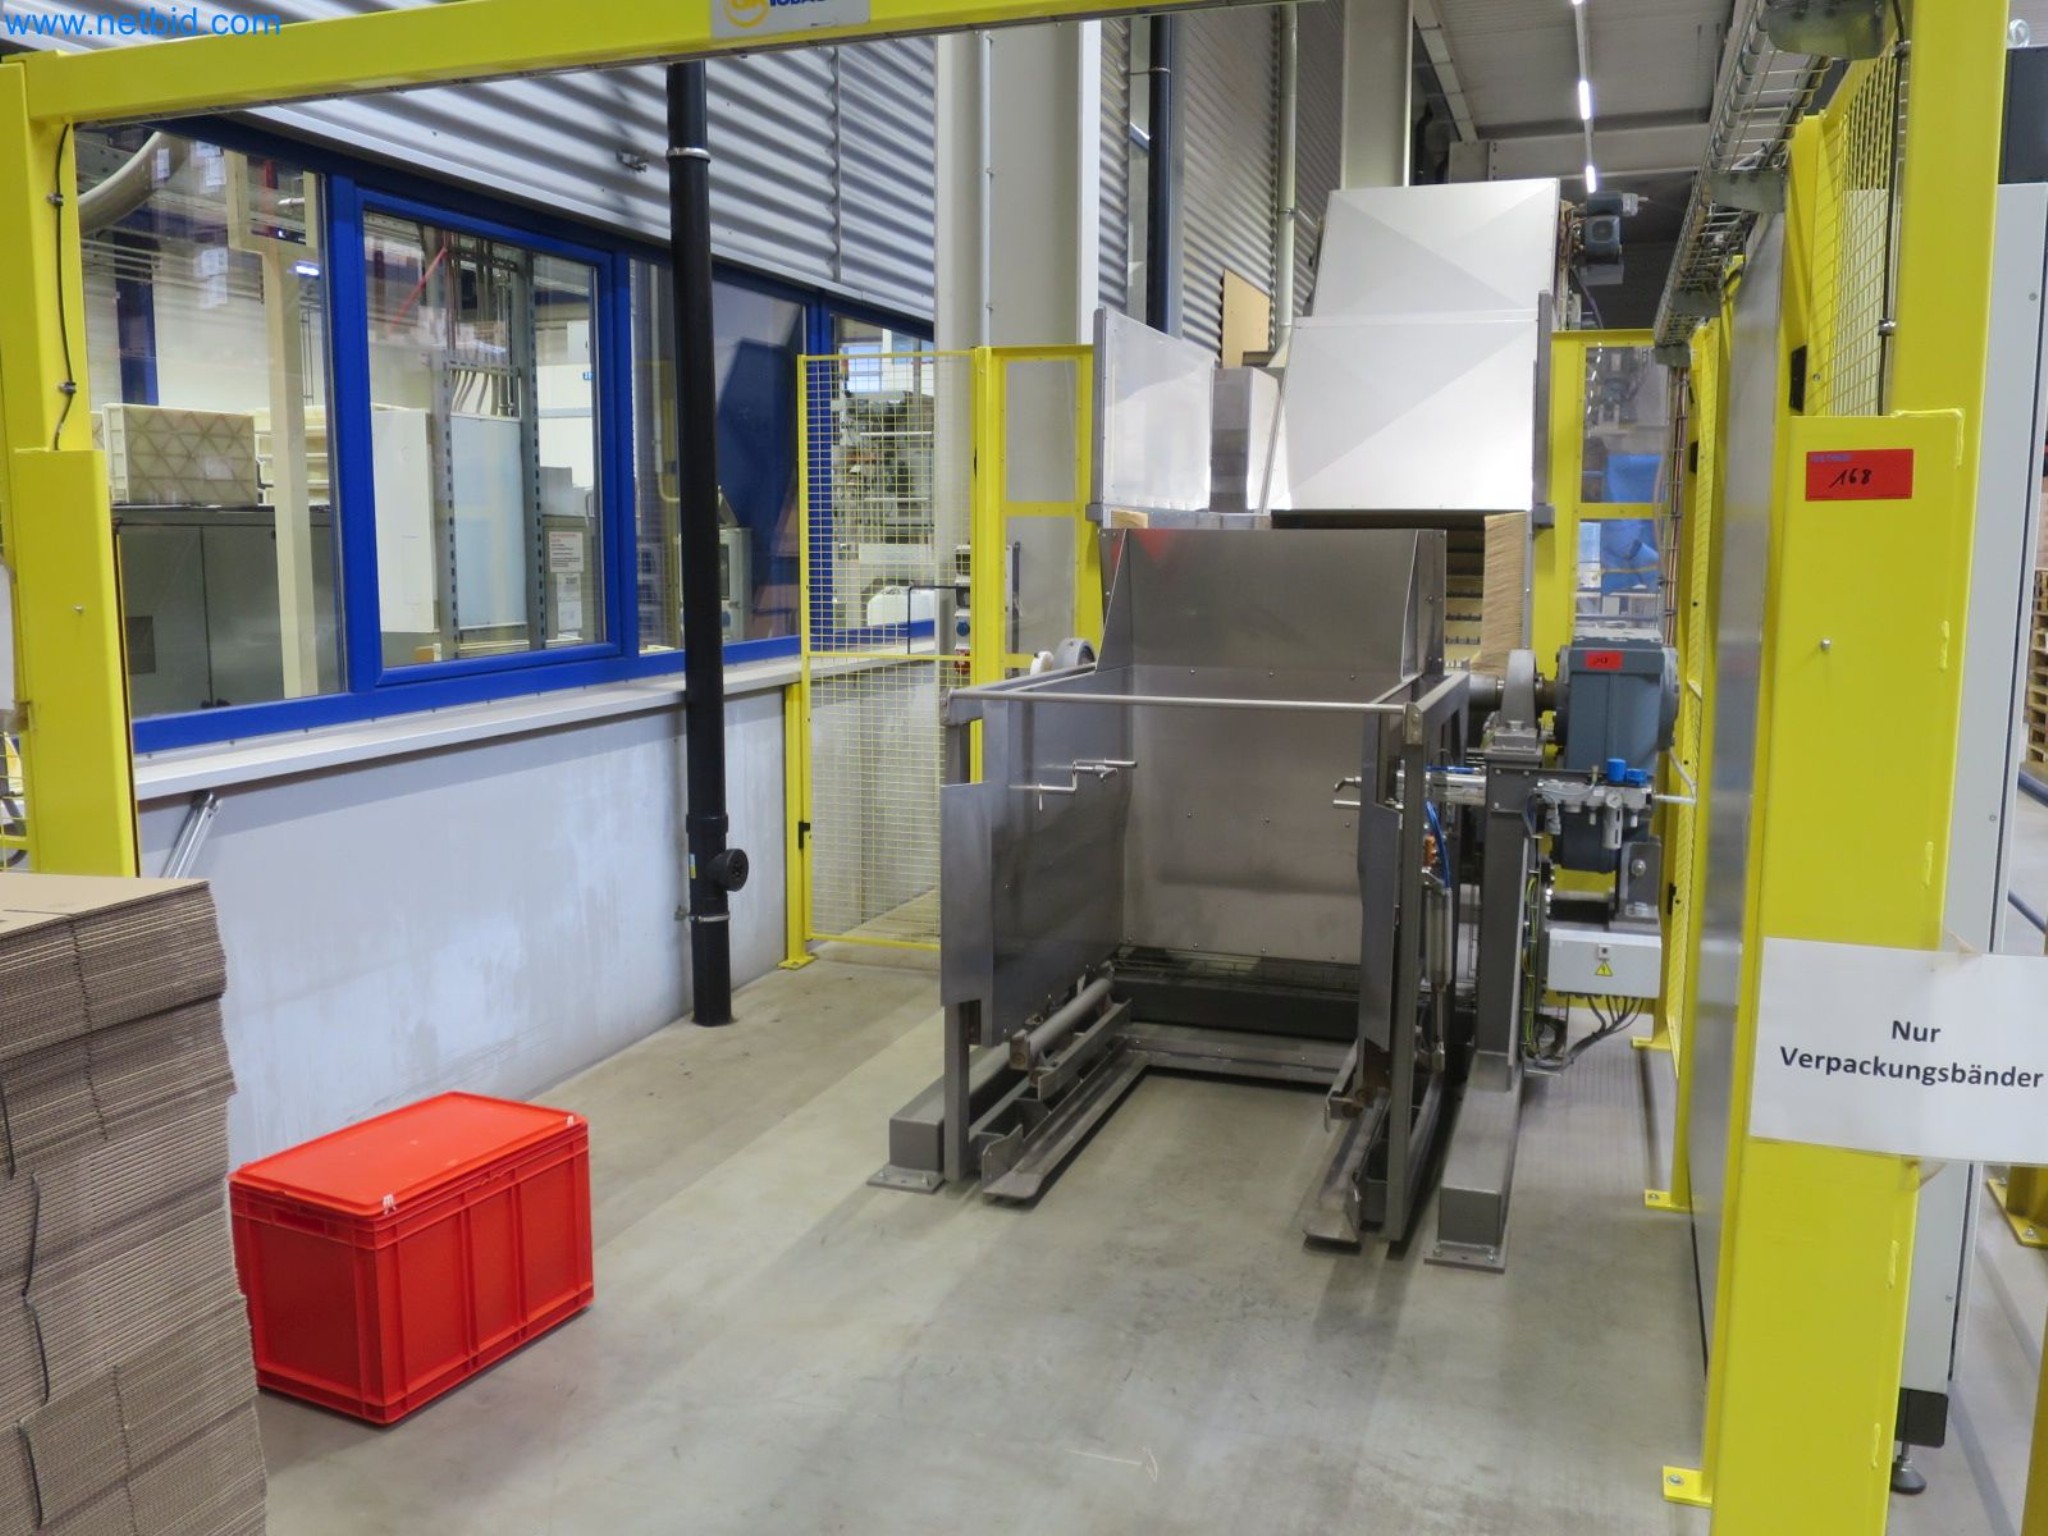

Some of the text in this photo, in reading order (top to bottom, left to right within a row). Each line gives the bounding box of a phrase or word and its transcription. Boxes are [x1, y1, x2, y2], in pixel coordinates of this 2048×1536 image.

[1828, 467, 1872, 488] 168
[1891, 1020, 1941, 1043] Nur
[1780, 1046, 2044, 1088] Verpackungsbänder
